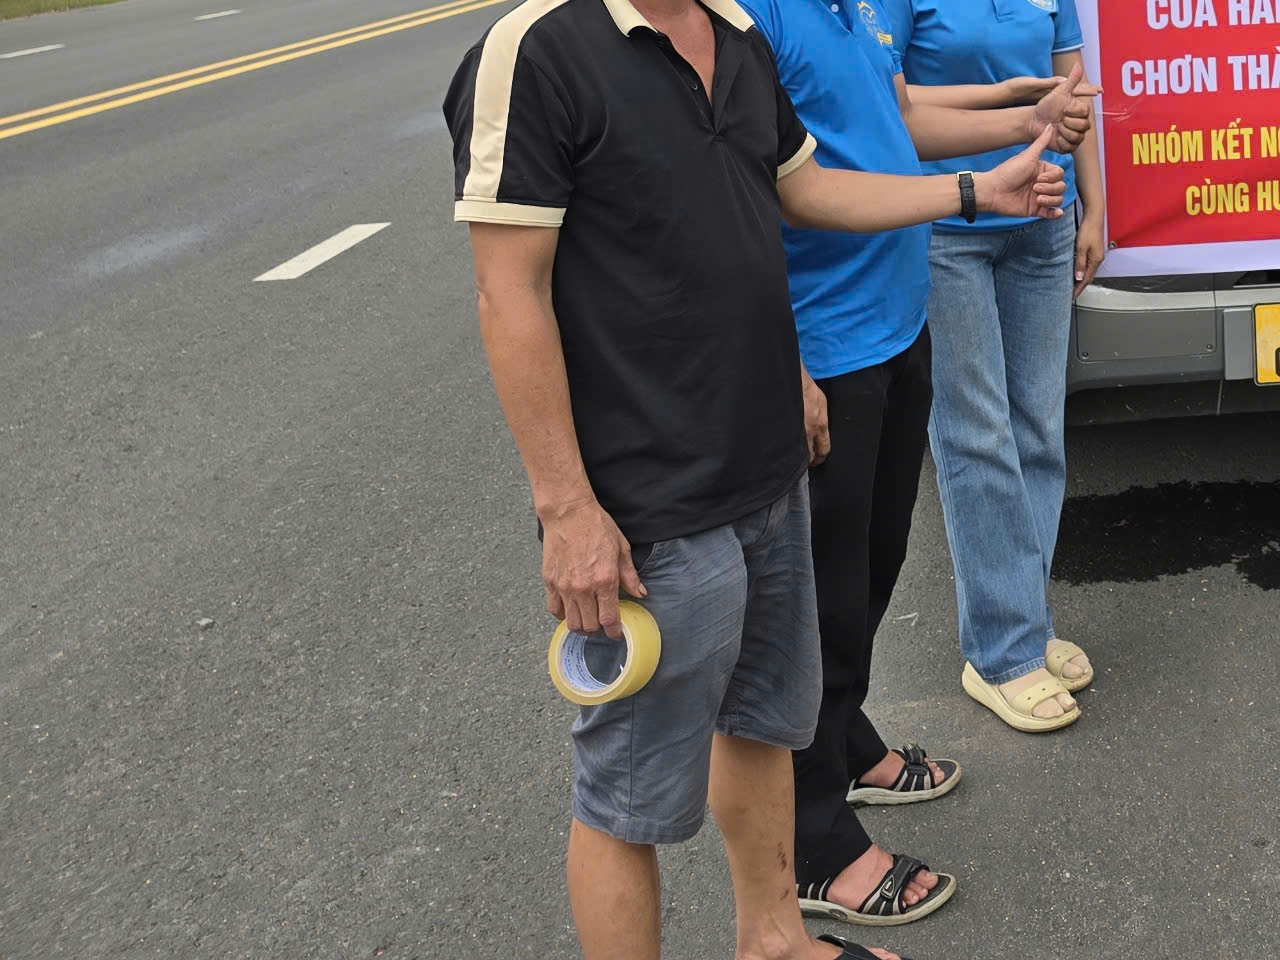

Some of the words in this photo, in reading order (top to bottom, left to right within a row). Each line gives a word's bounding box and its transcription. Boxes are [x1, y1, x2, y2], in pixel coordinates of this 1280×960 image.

[1122, 55, 1217, 96] CHƠN
[1132, 123, 1203, 165] NHÓM
[1211, 118, 1253, 160] KẾT
[1186, 177, 1249, 216] CÙNG
